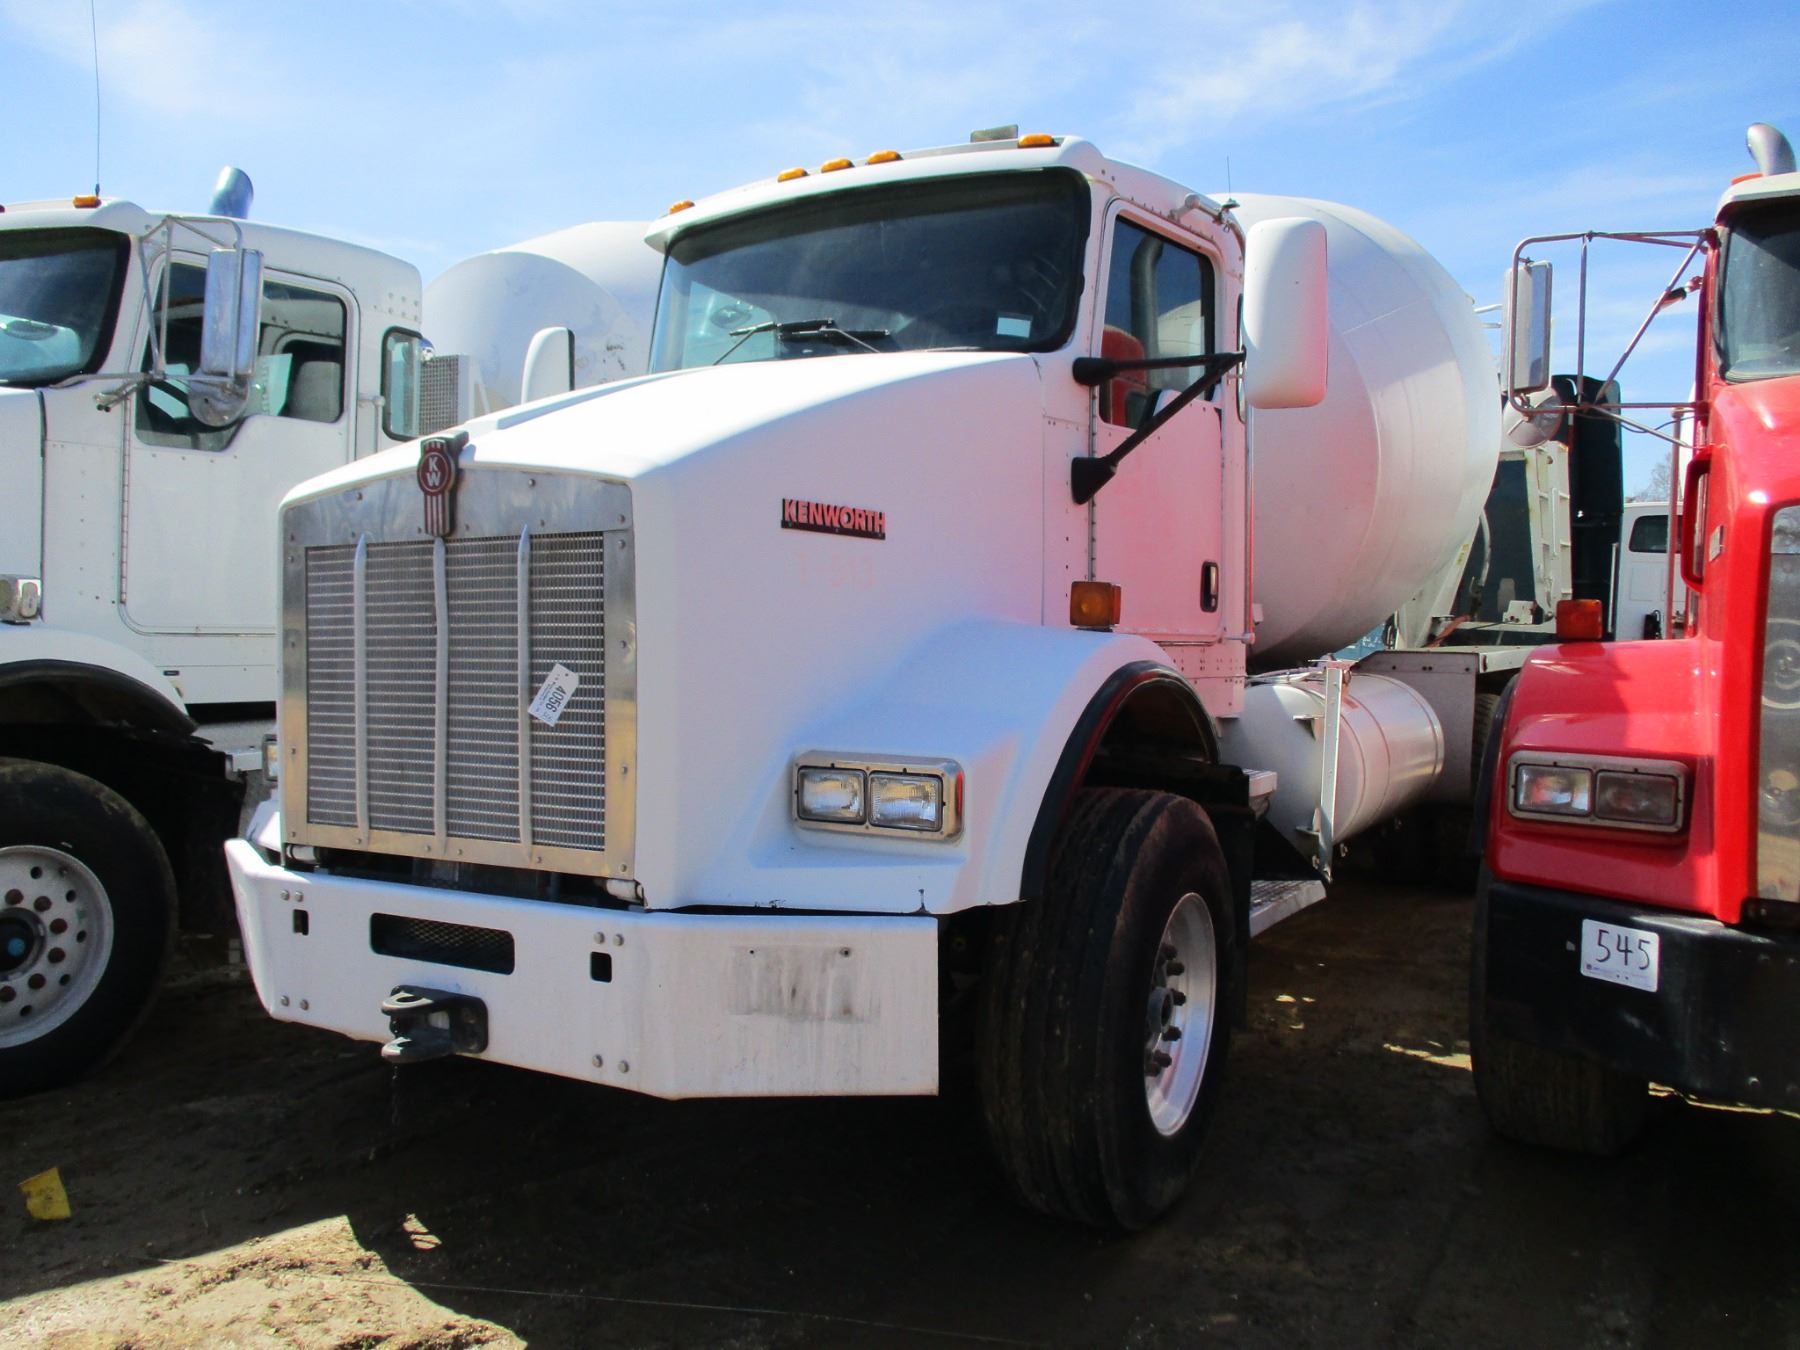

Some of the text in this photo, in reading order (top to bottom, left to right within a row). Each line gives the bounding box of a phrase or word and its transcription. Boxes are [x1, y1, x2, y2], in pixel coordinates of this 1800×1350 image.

[783, 498, 887, 534] KENWORTH
[546, 685, 567, 713] 4056
[1595, 928, 1651, 971] 545
